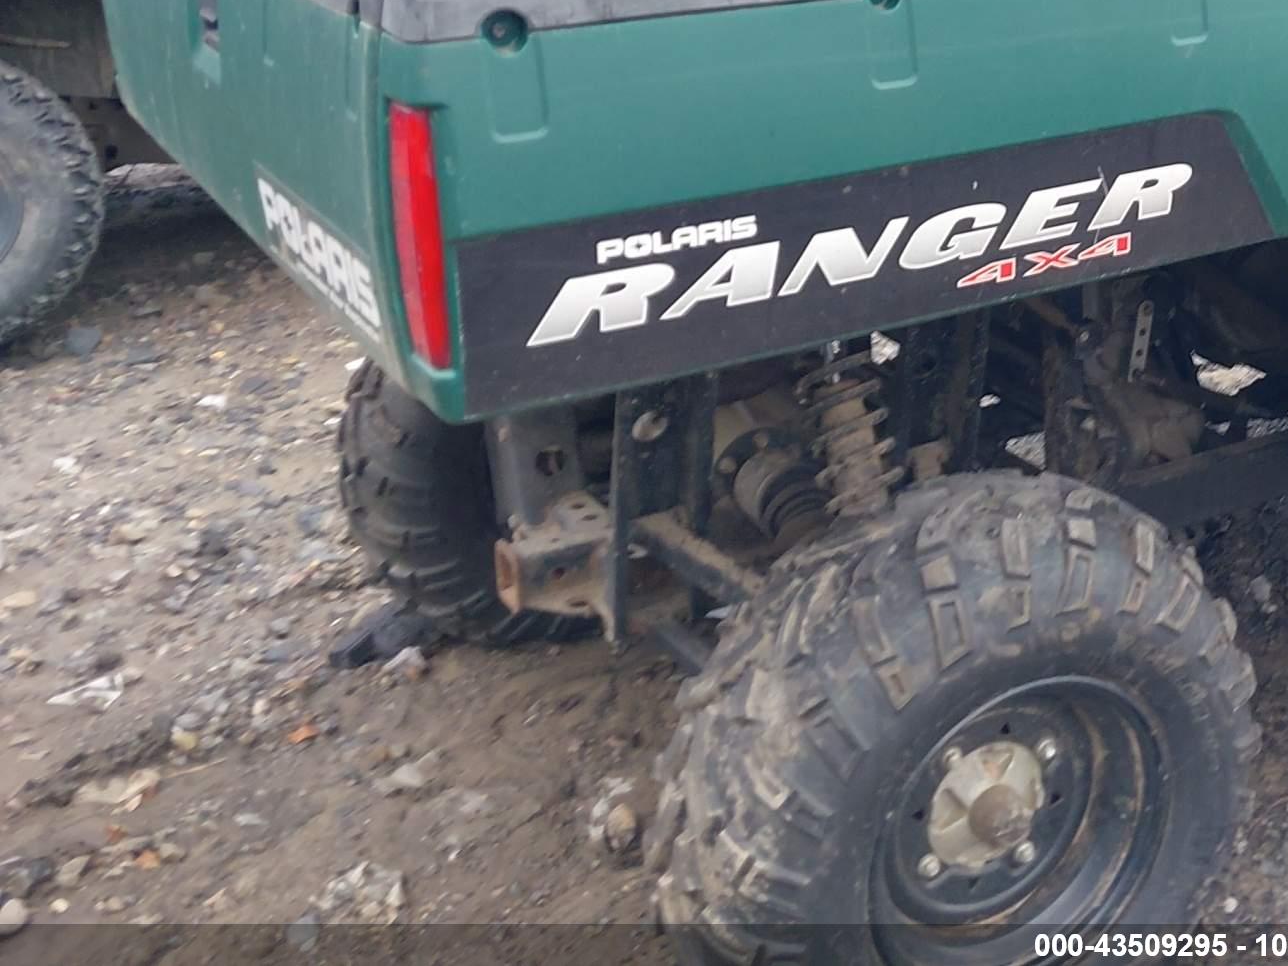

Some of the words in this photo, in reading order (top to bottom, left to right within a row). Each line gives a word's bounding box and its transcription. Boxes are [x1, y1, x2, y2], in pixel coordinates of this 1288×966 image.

[257, 177, 381, 328] POLARIS
[526, 163, 1193, 346] RANGER
[597, 215, 758, 263] POLARIS
